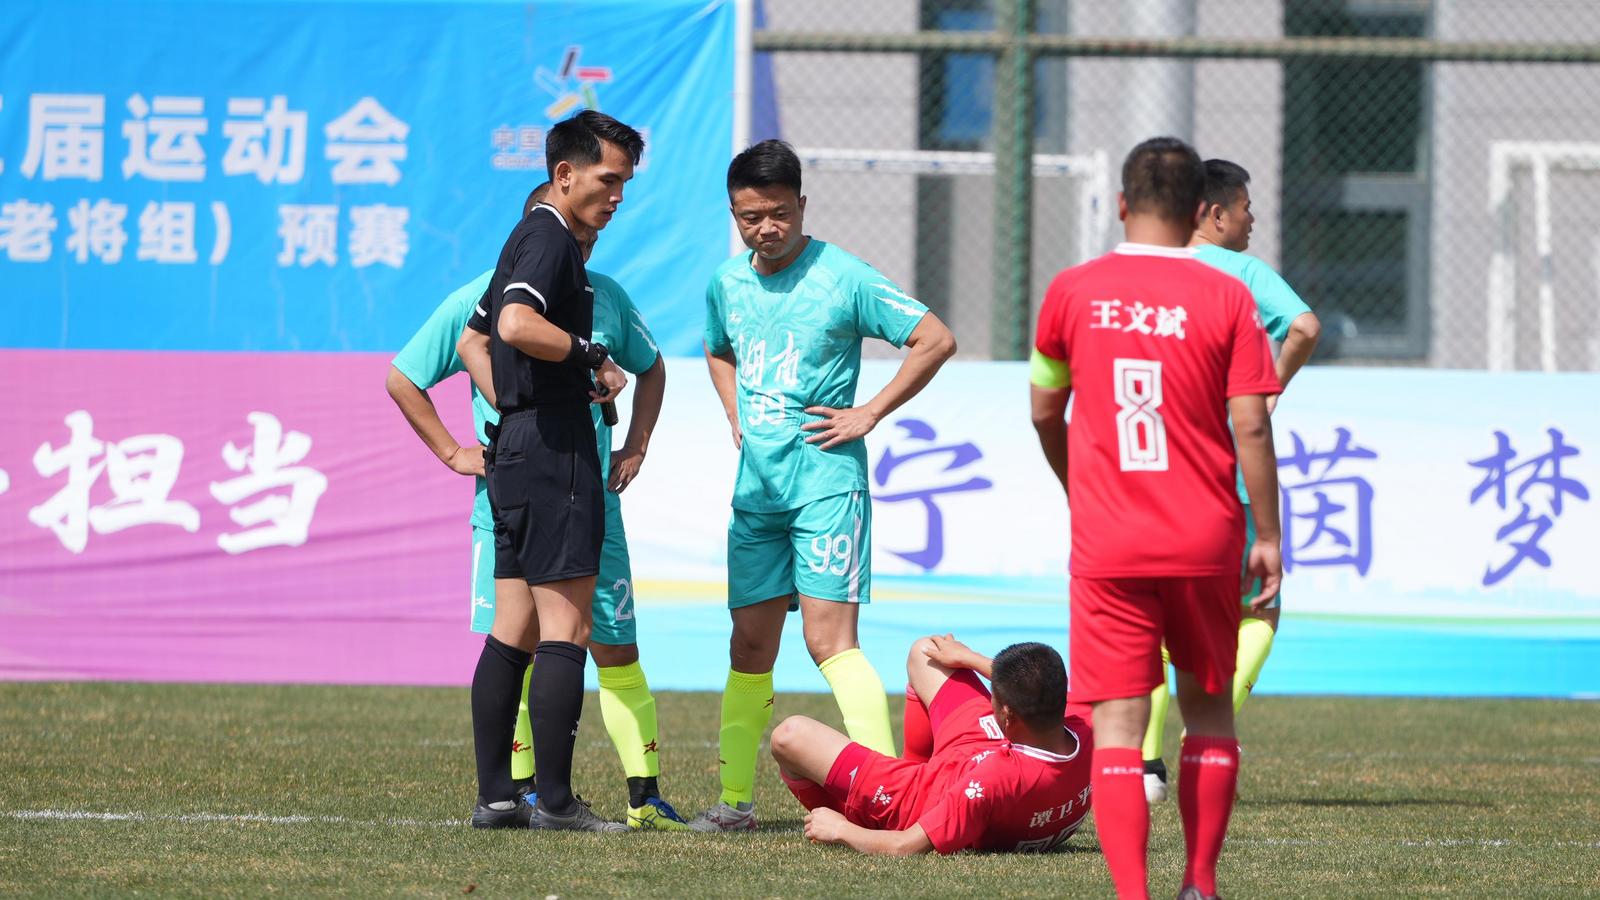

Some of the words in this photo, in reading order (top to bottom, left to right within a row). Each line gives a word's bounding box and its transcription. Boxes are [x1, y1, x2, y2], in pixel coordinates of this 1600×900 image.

[0, 93, 410, 186] 届运动会
[1089, 298, 1188, 340] 王文斌
[1113, 357, 1169, 472] 8
[0, 410, 328, 554] 担当
[807, 534, 852, 577] 99
[613, 578, 635, 621] 2
